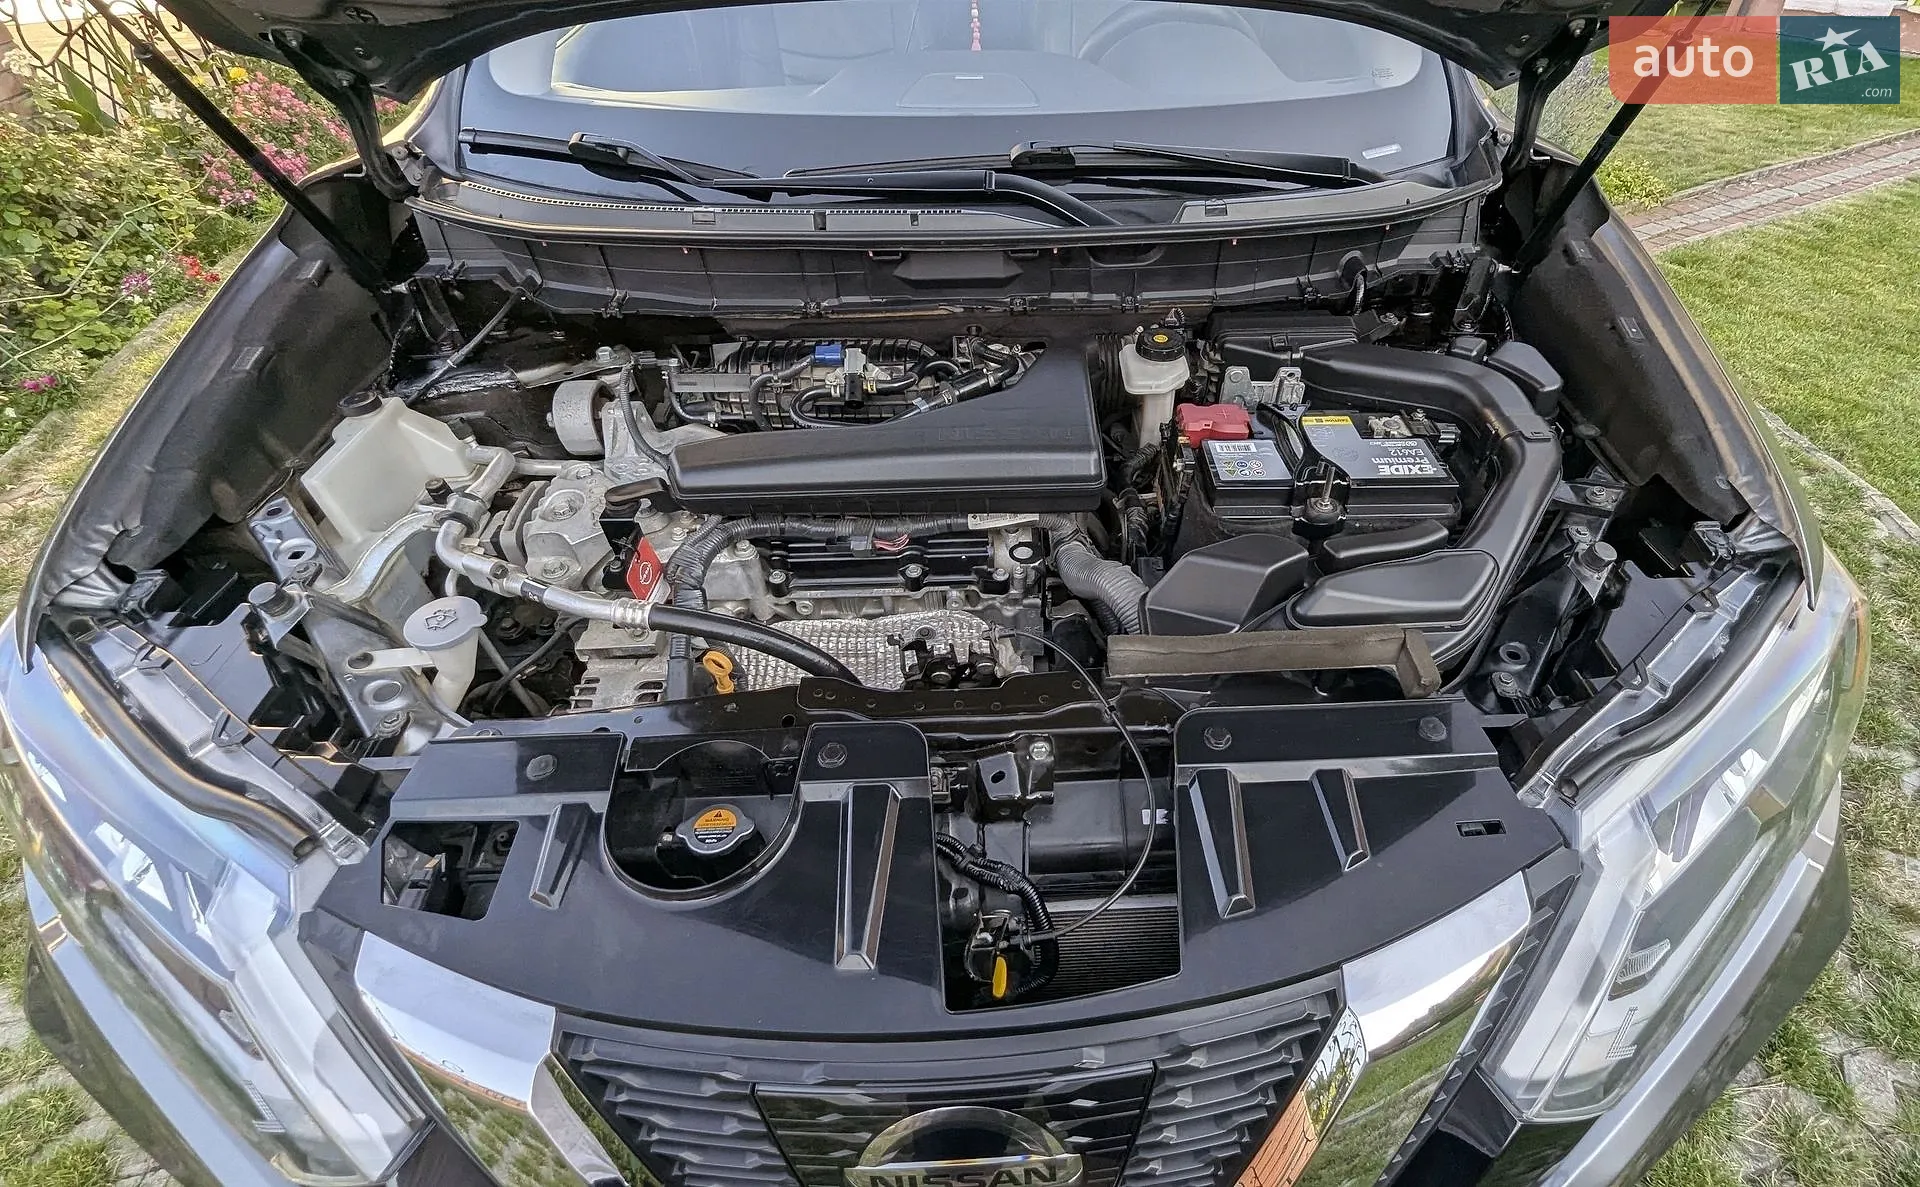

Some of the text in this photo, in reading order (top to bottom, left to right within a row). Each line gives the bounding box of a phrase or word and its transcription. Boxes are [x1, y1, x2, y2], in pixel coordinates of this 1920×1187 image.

[1388, 447, 1425, 456] EA612
[1371, 456, 1430, 465] Premium
[1379, 464, 1434, 475] EXIDE
[869, 1166, 1057, 1187] NISSAN
